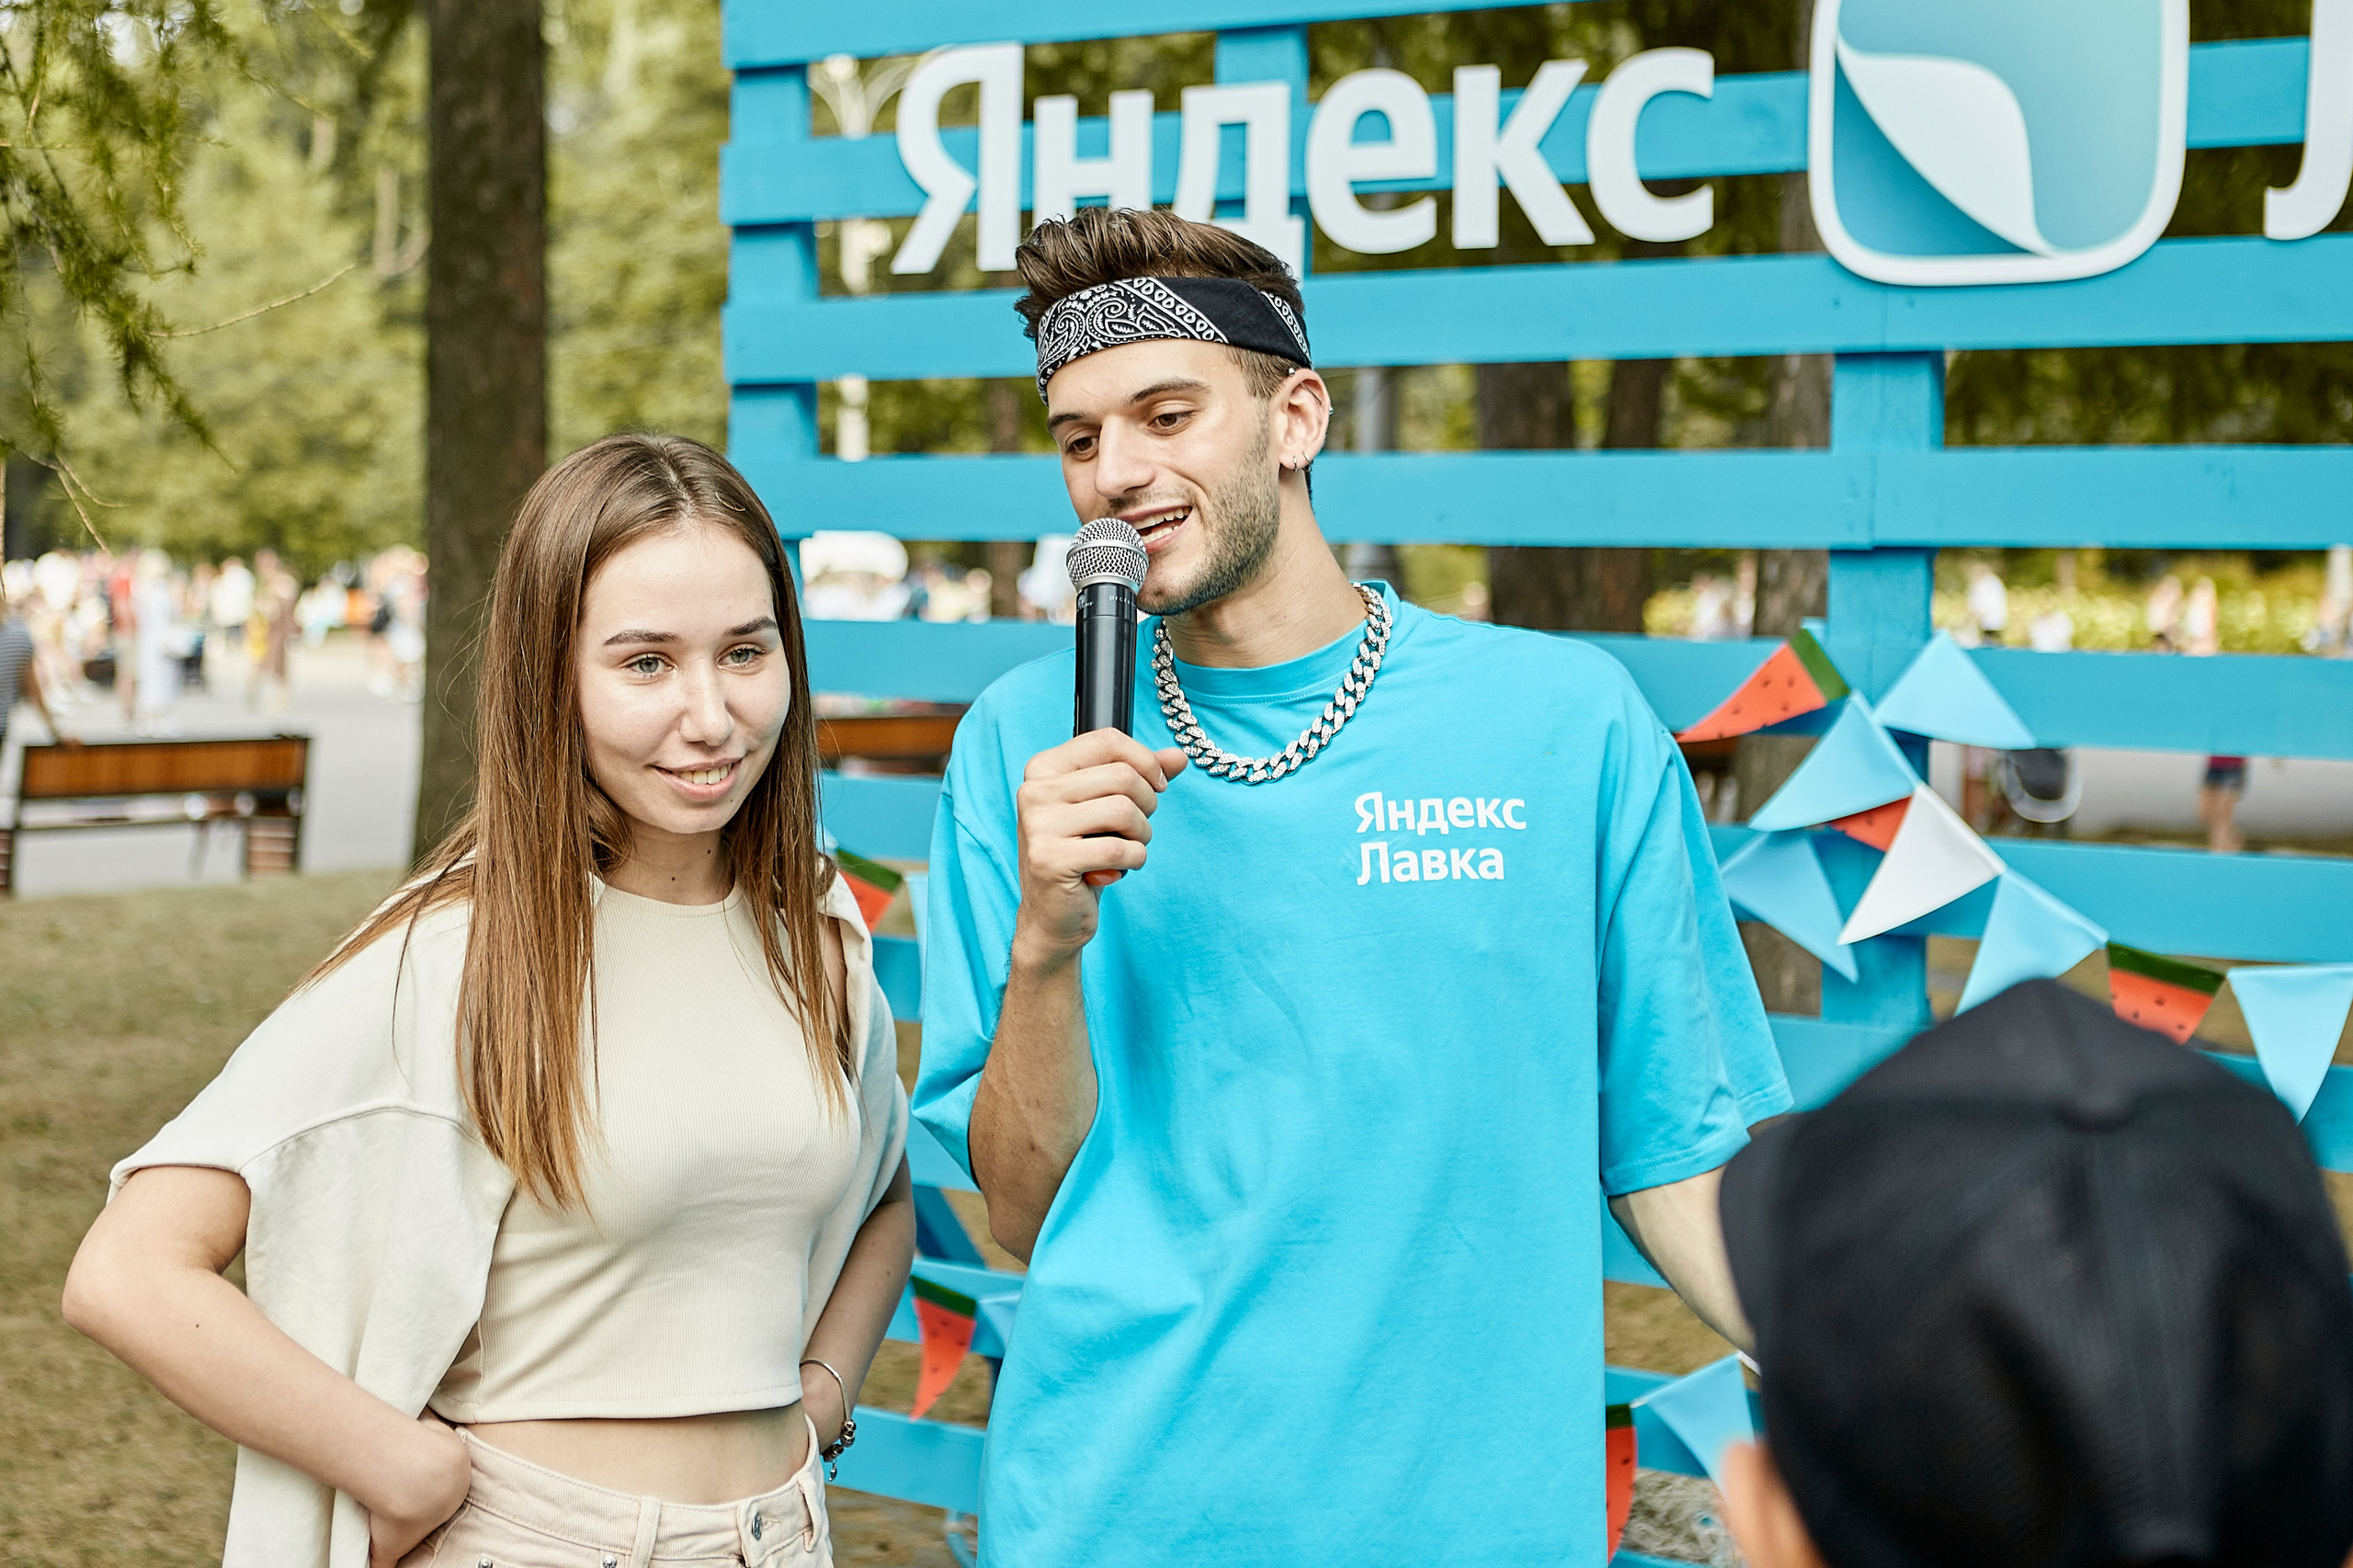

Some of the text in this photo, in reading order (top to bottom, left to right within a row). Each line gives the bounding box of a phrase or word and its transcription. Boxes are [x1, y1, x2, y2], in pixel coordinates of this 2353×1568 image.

[892, 41, 1714, 285] Яндекс
[1354, 790, 1527, 835] Яндекс
[1356, 841, 1505, 885] Лавка
